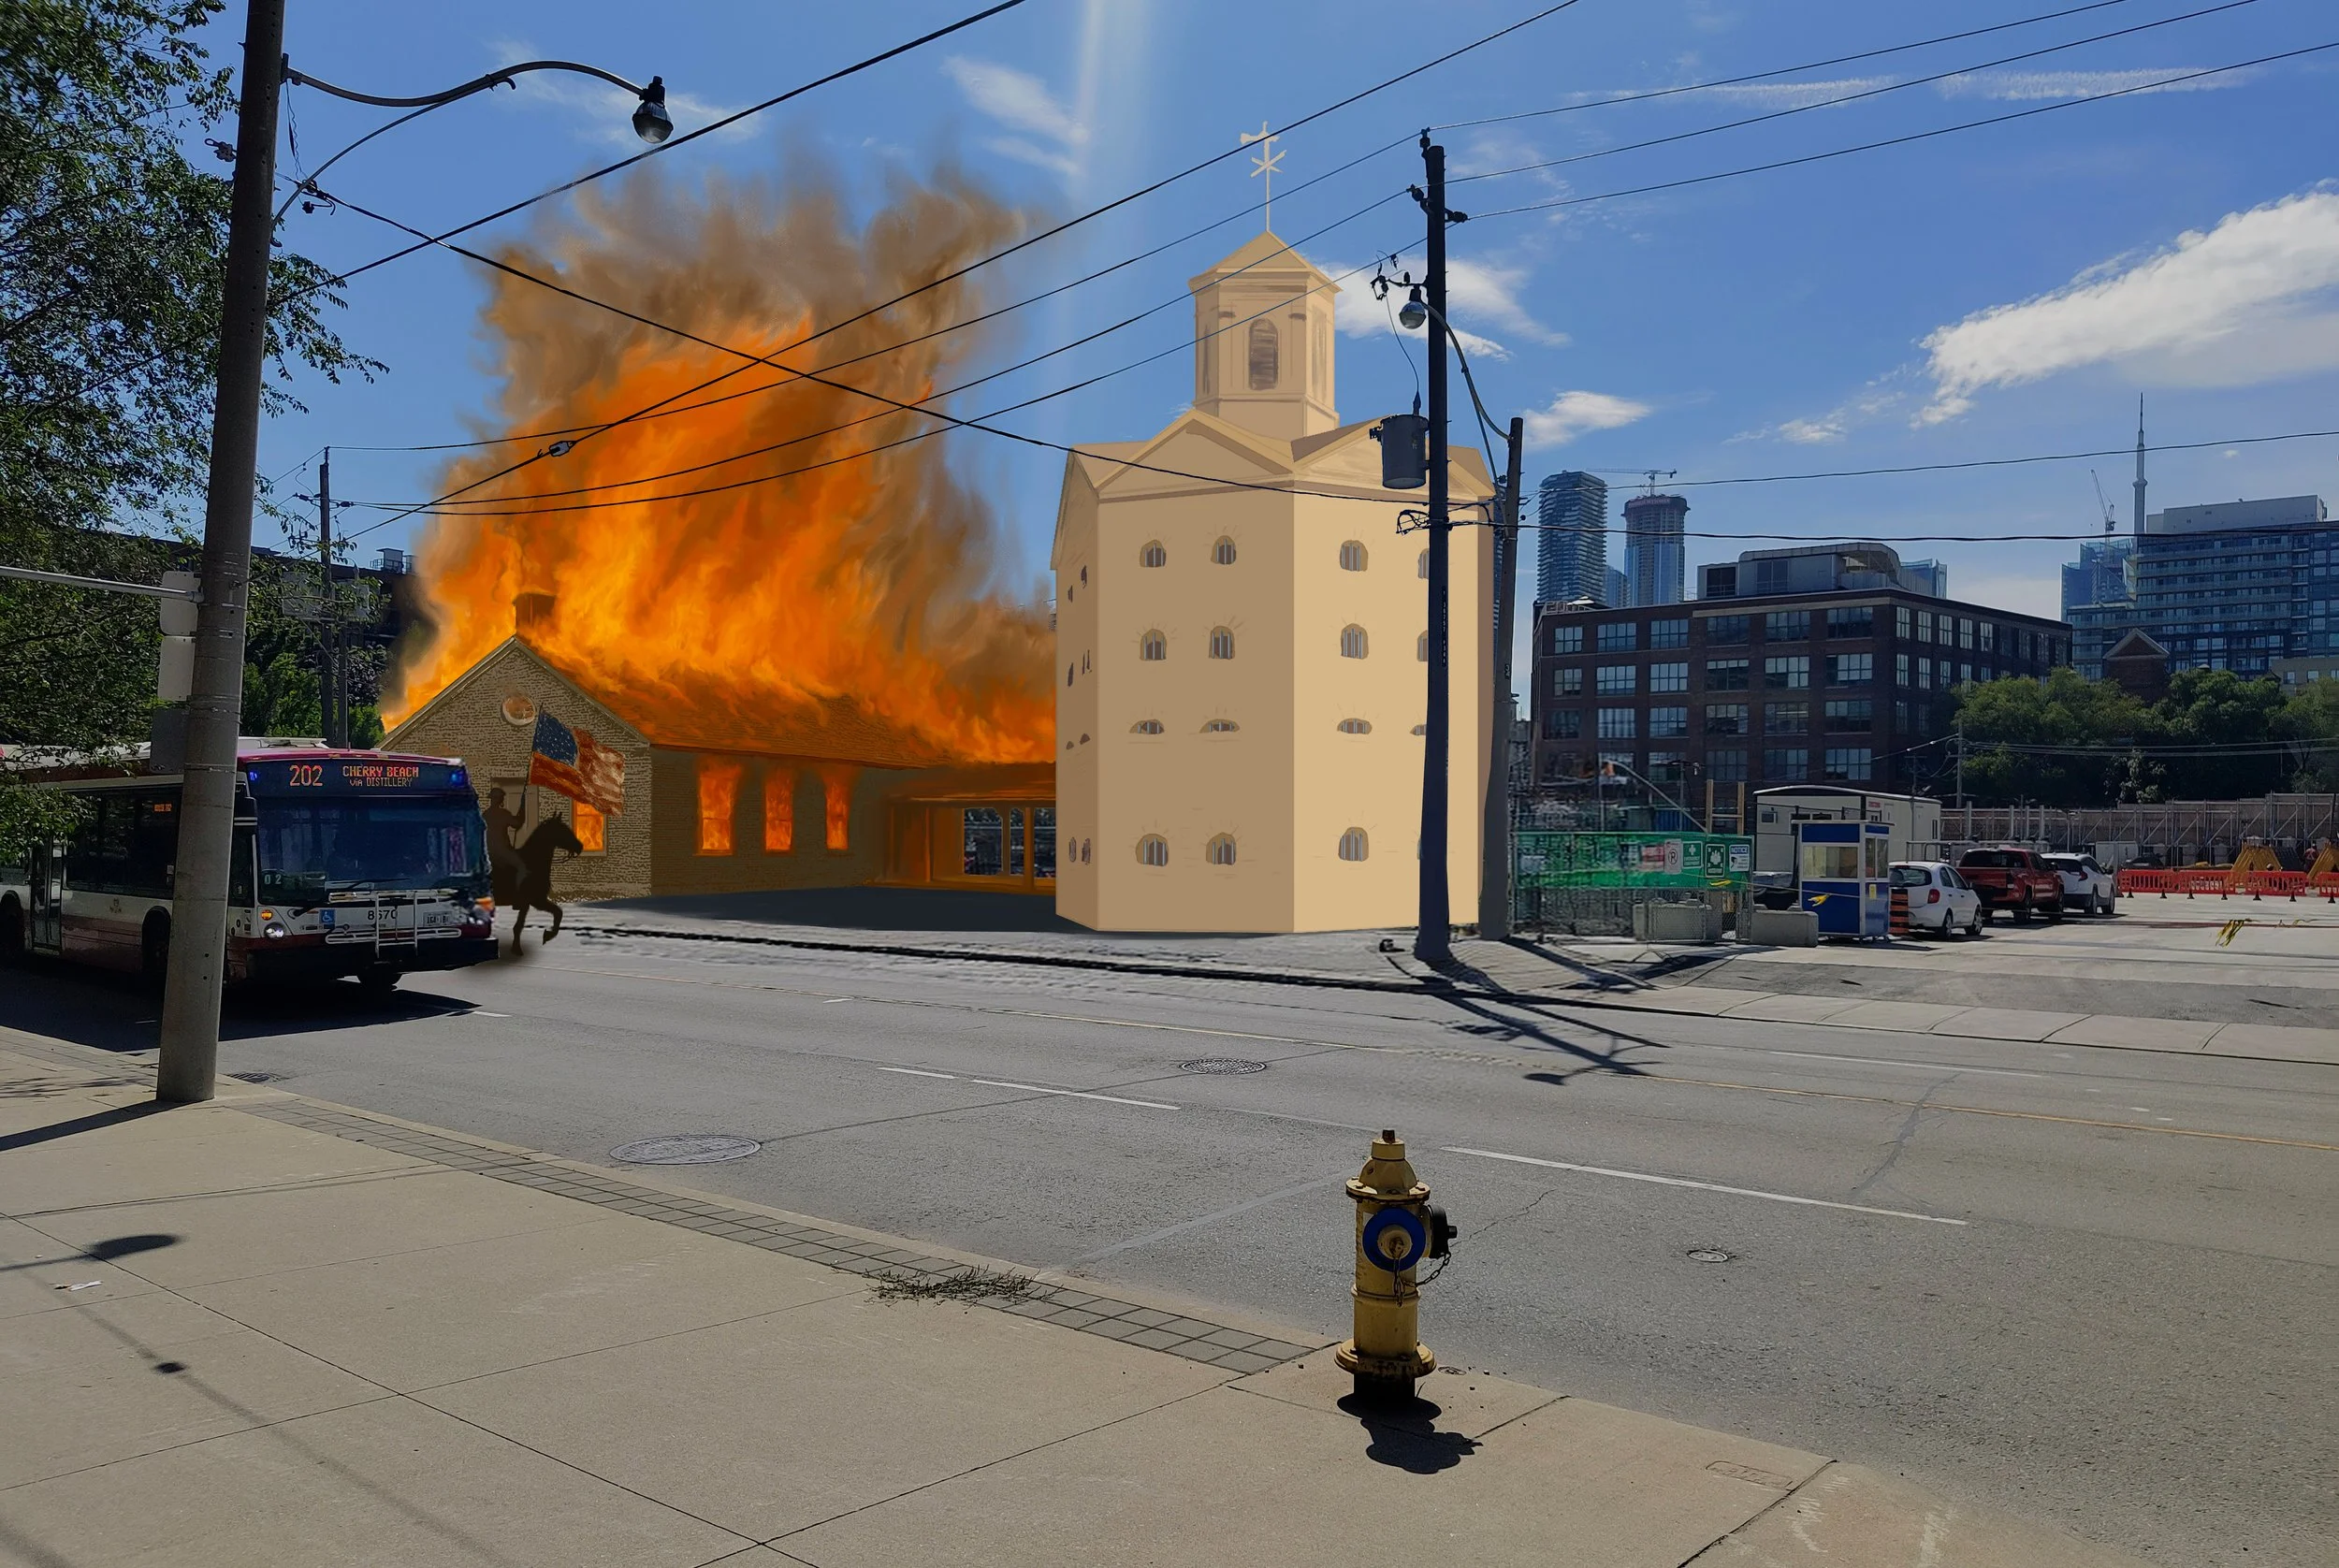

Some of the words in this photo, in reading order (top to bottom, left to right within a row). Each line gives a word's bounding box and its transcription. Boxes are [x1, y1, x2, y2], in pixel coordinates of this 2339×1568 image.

[289, 764, 324, 787] 202
[342, 765, 384, 777] CHERRY
[386, 766, 419, 777] BEACH
[366, 777, 413, 787] DISTILLERY
